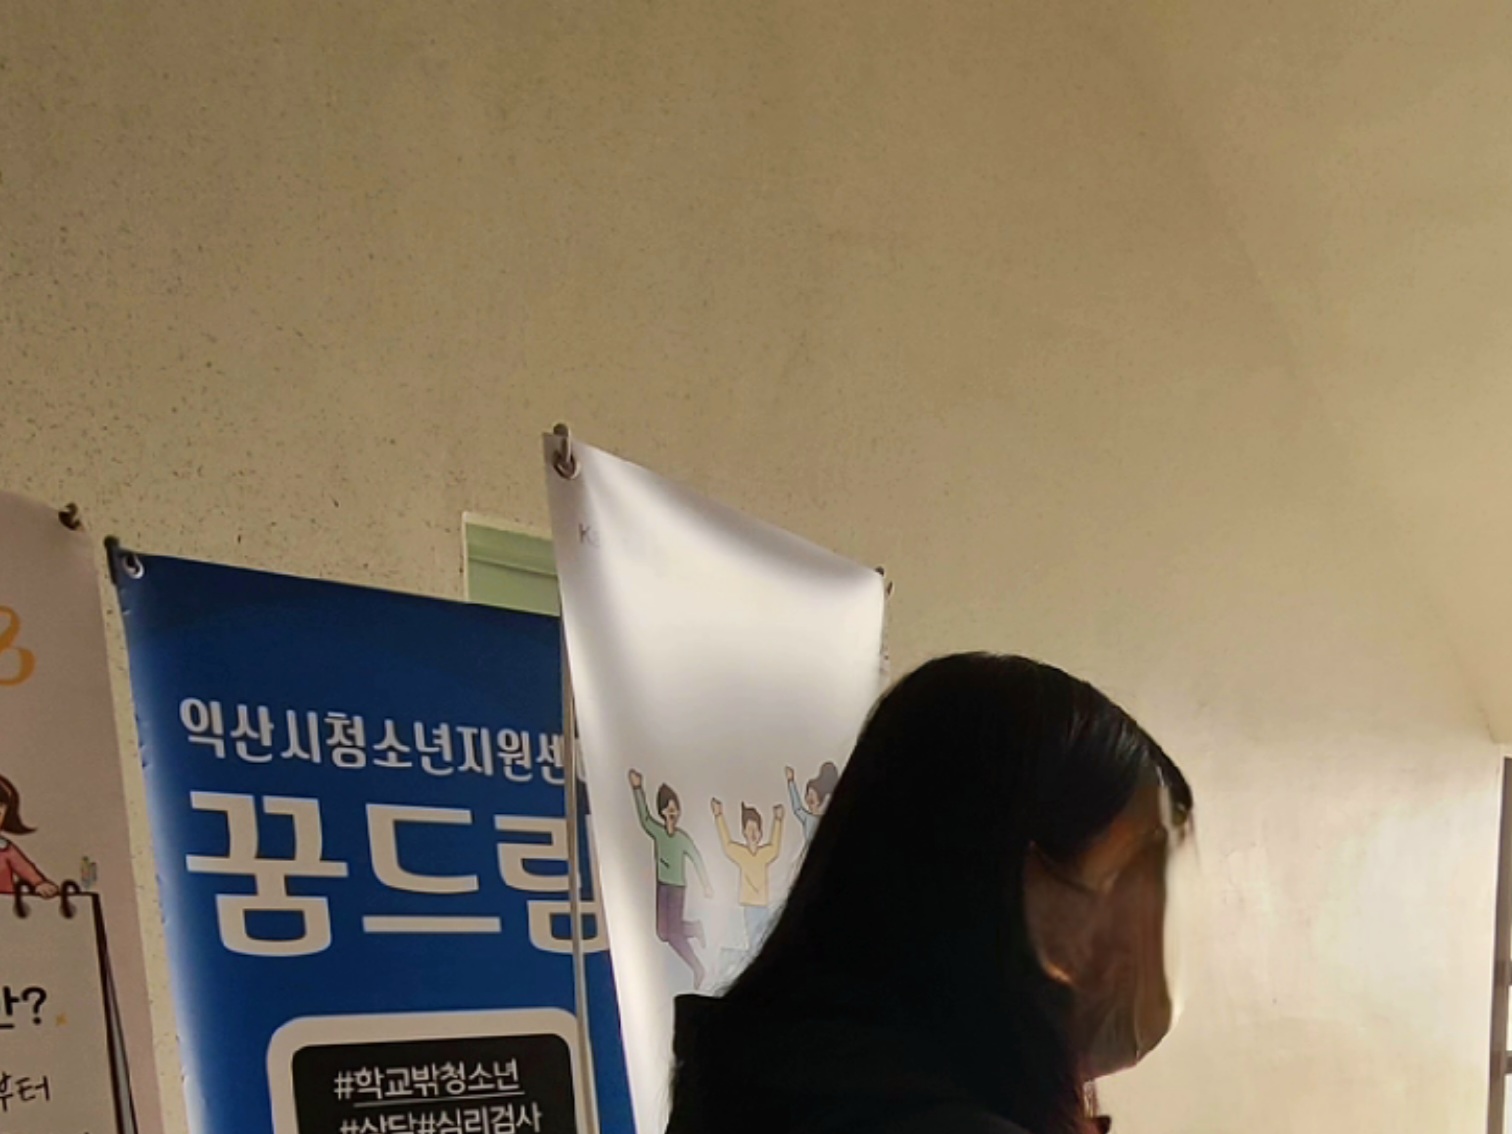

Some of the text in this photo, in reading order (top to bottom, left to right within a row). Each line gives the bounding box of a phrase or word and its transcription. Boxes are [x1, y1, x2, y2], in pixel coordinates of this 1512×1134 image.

[179, 697, 587, 786] 익산시청소년지원센
[186, 790, 610, 958] 꿈드림
[334, 1058, 520, 1100] #학교밖청소년
